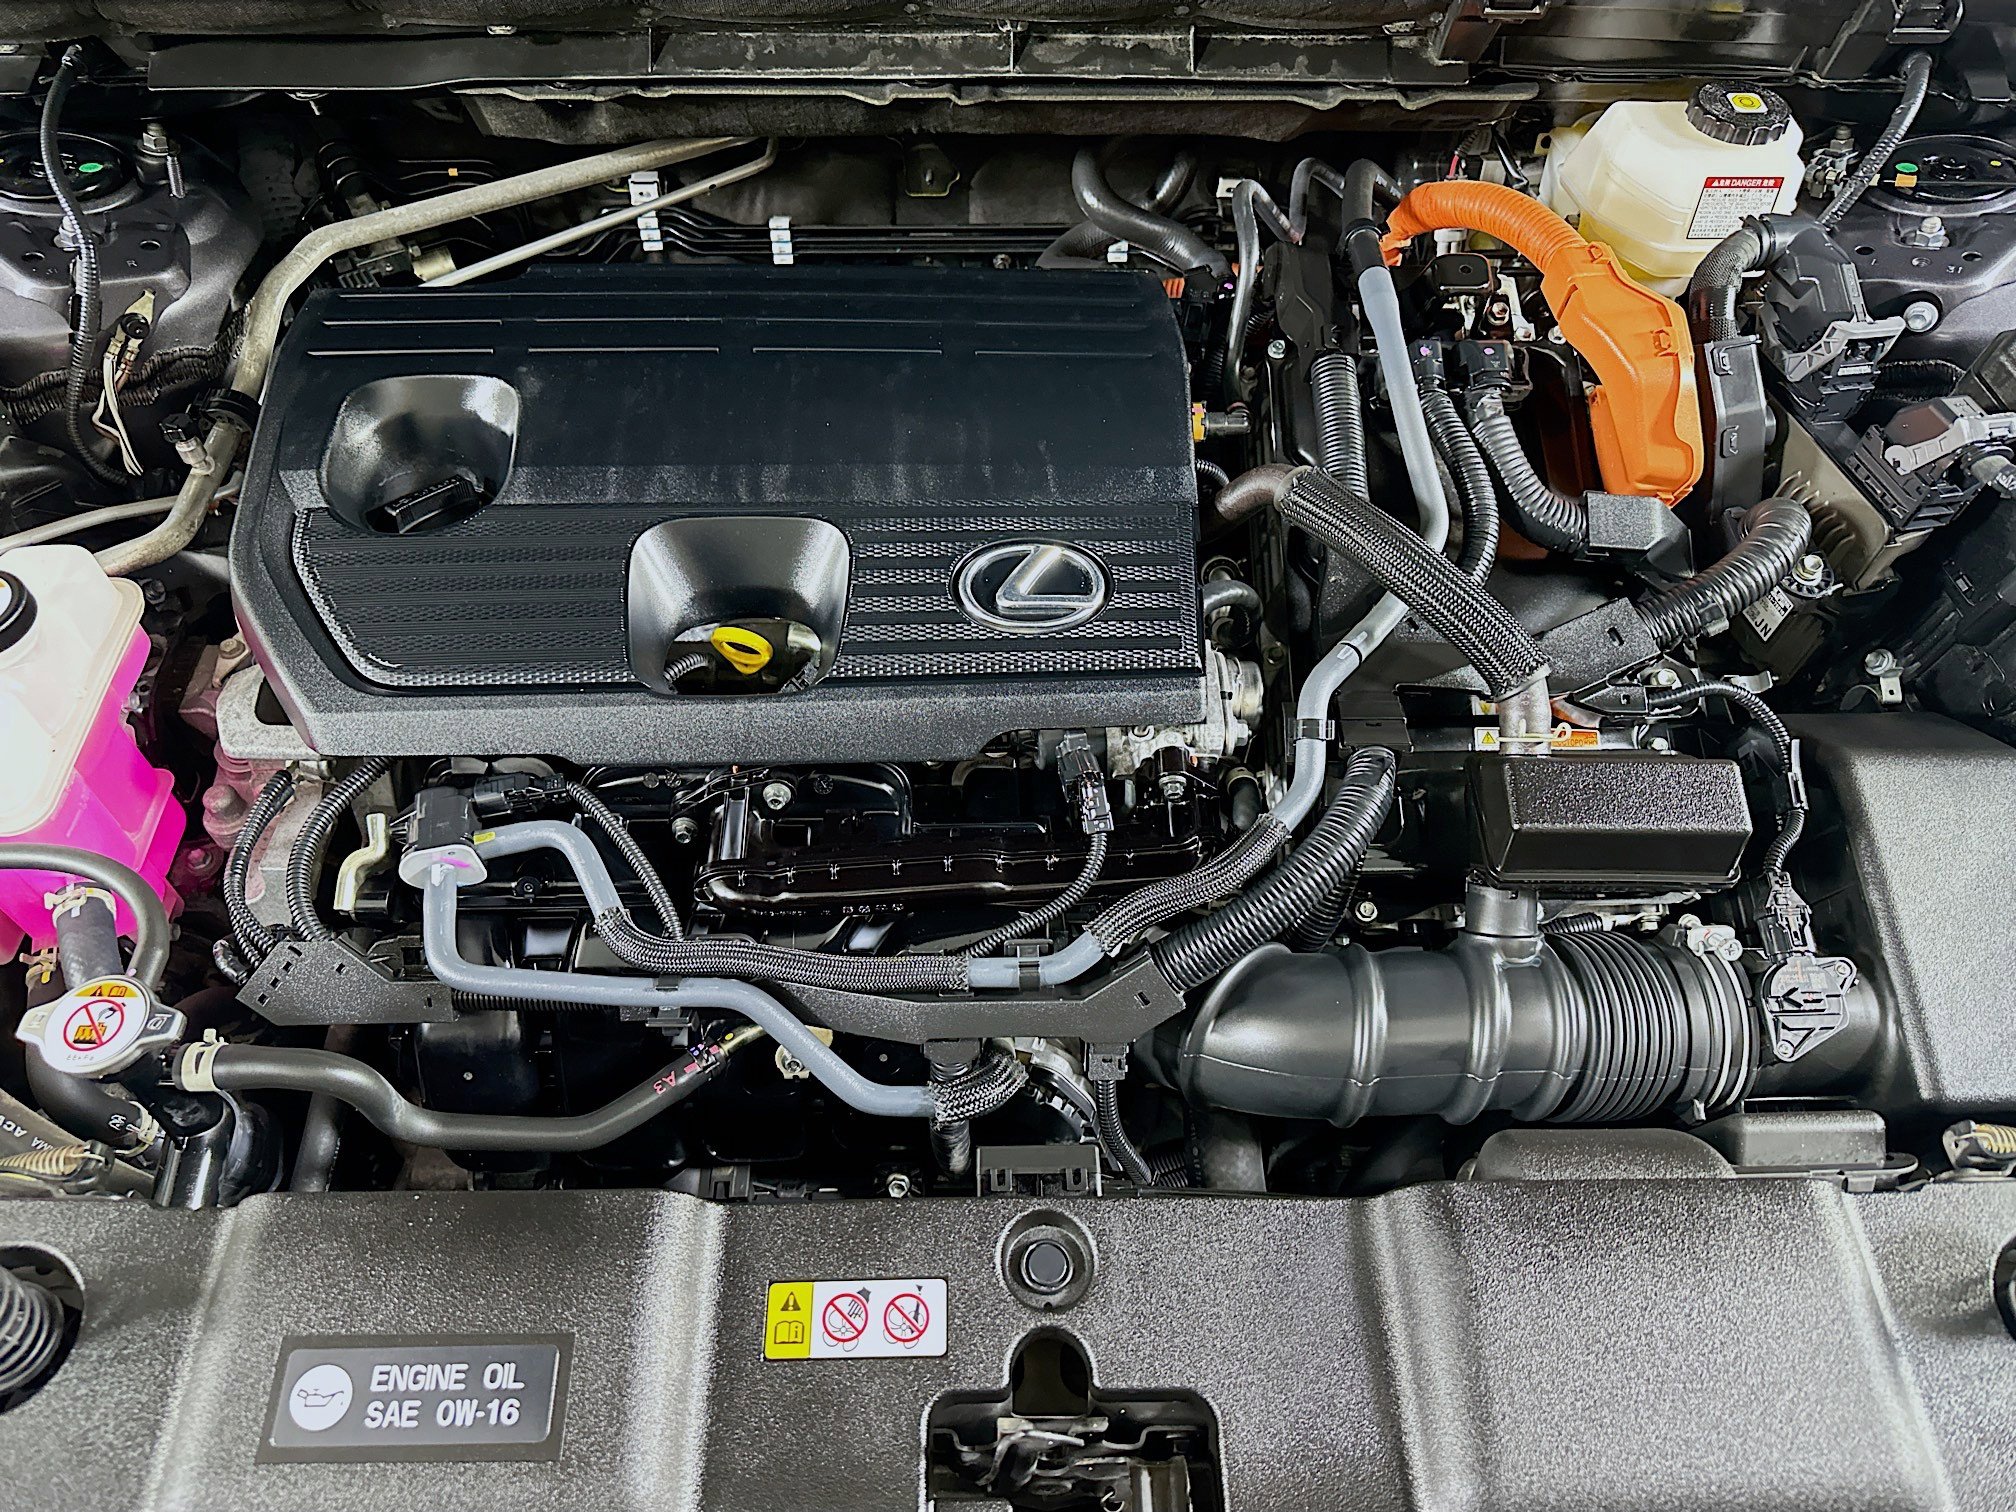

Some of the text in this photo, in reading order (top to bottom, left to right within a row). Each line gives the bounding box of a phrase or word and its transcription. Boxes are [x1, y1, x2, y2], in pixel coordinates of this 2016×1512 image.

[1730, 179, 1762, 187] DANGER
[1754, 618, 1772, 638] JN
[653, 1070, 676, 1095] A3
[370, 1362, 525, 1392] ENGINE OIL
[364, 1398, 521, 1428] SAE 0W-16
